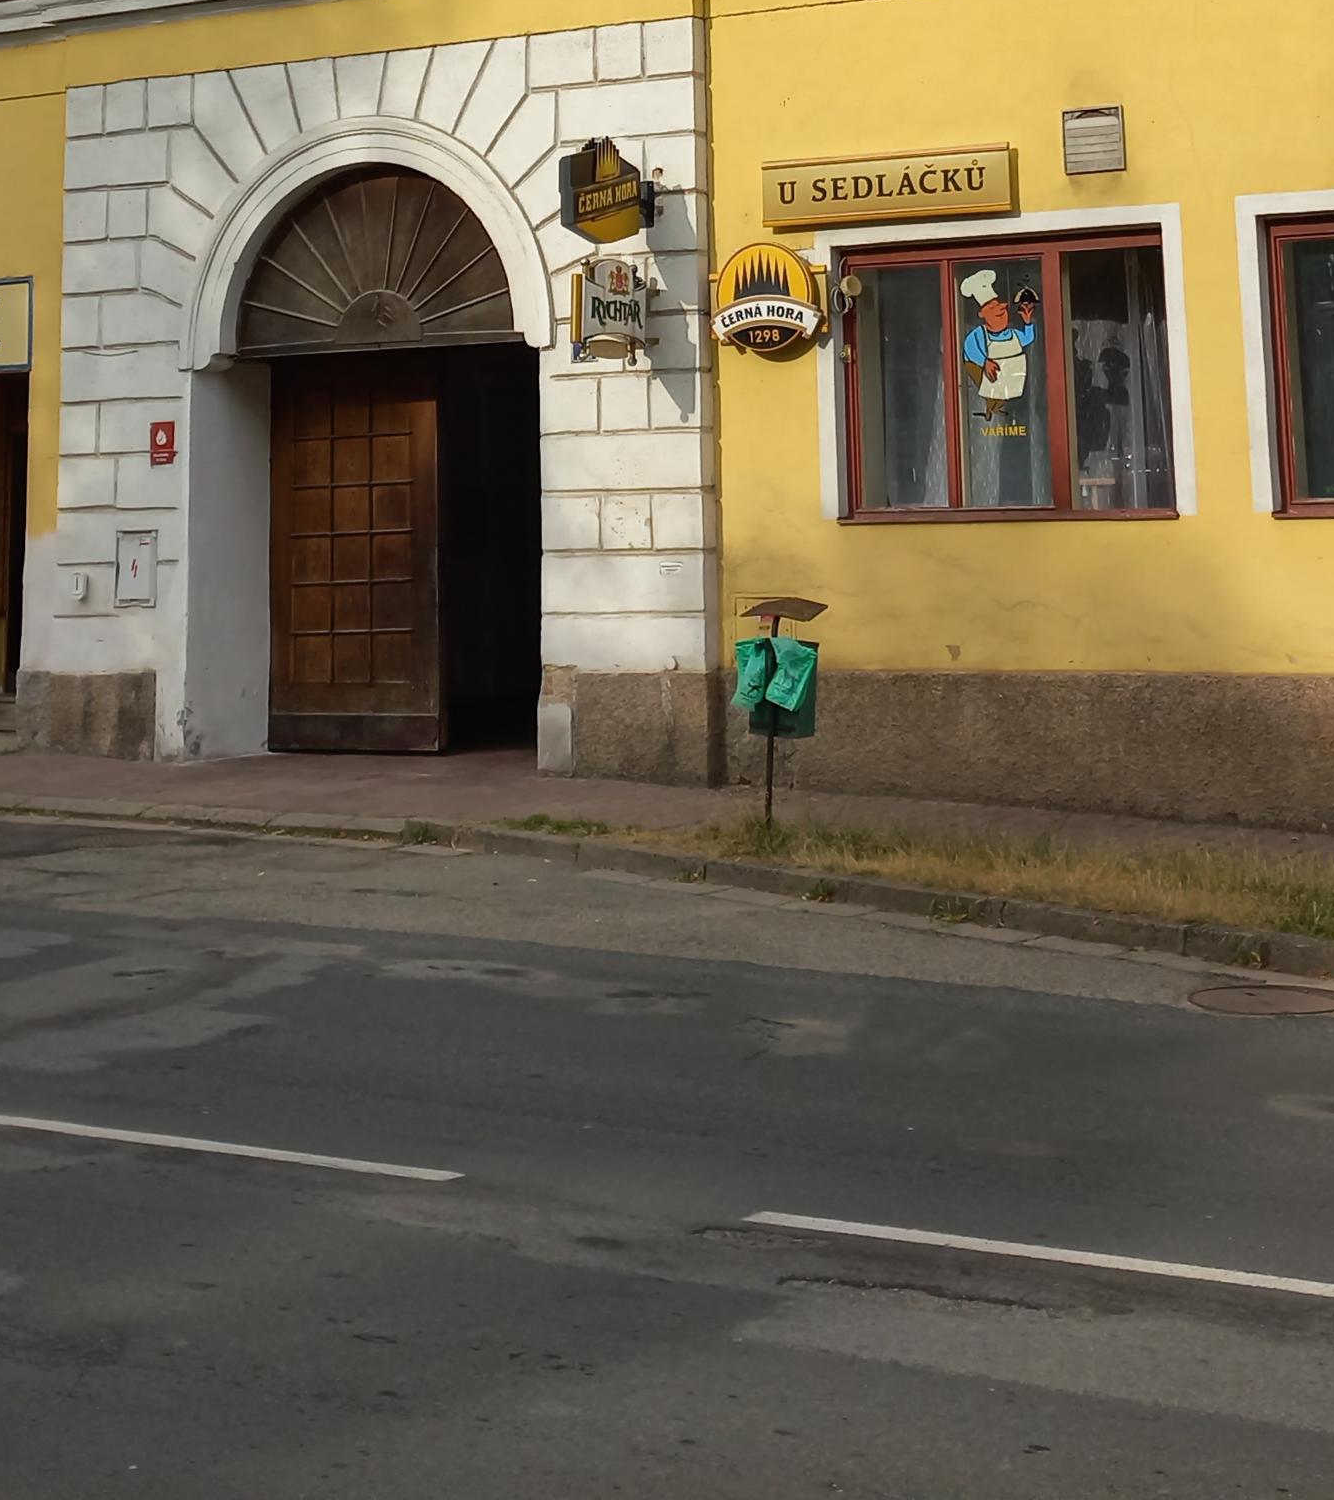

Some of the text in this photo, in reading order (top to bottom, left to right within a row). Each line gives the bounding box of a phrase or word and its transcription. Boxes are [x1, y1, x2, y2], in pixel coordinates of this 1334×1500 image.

[777, 159, 986, 205] U SEDLÁČKŮ
[578, 180, 638, 214] ČERNÁ HORA
[720, 303, 805, 328] ČERNÁ HORA
[748, 329, 780, 343] 1298
